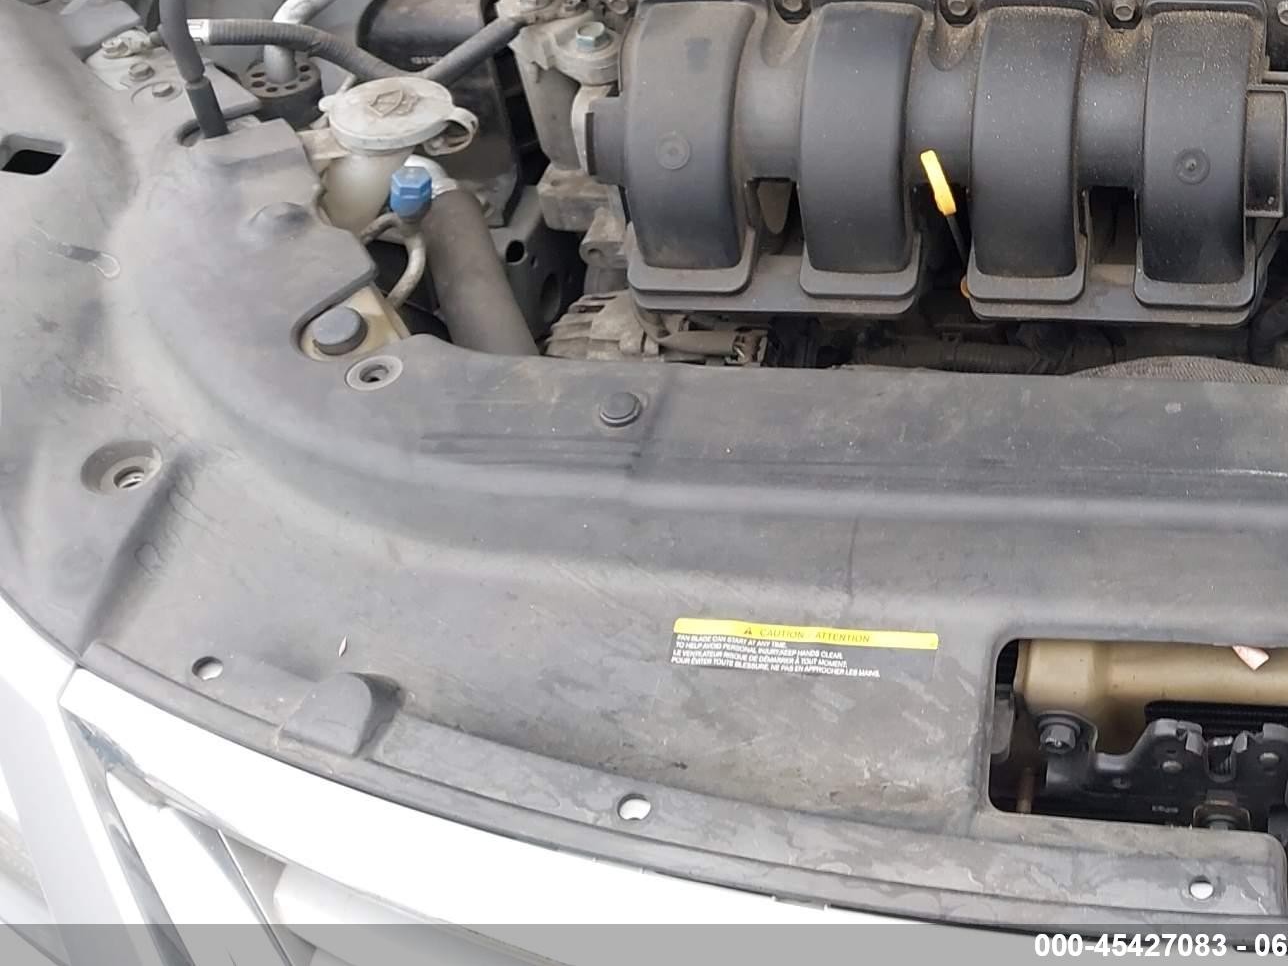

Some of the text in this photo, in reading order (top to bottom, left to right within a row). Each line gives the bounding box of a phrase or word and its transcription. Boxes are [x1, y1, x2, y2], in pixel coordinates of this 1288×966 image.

[759, 627, 870, 643] CAUTION ATTENTION
[675, 640, 684, 648] TO
[685, 641, 702, 649] HELP
